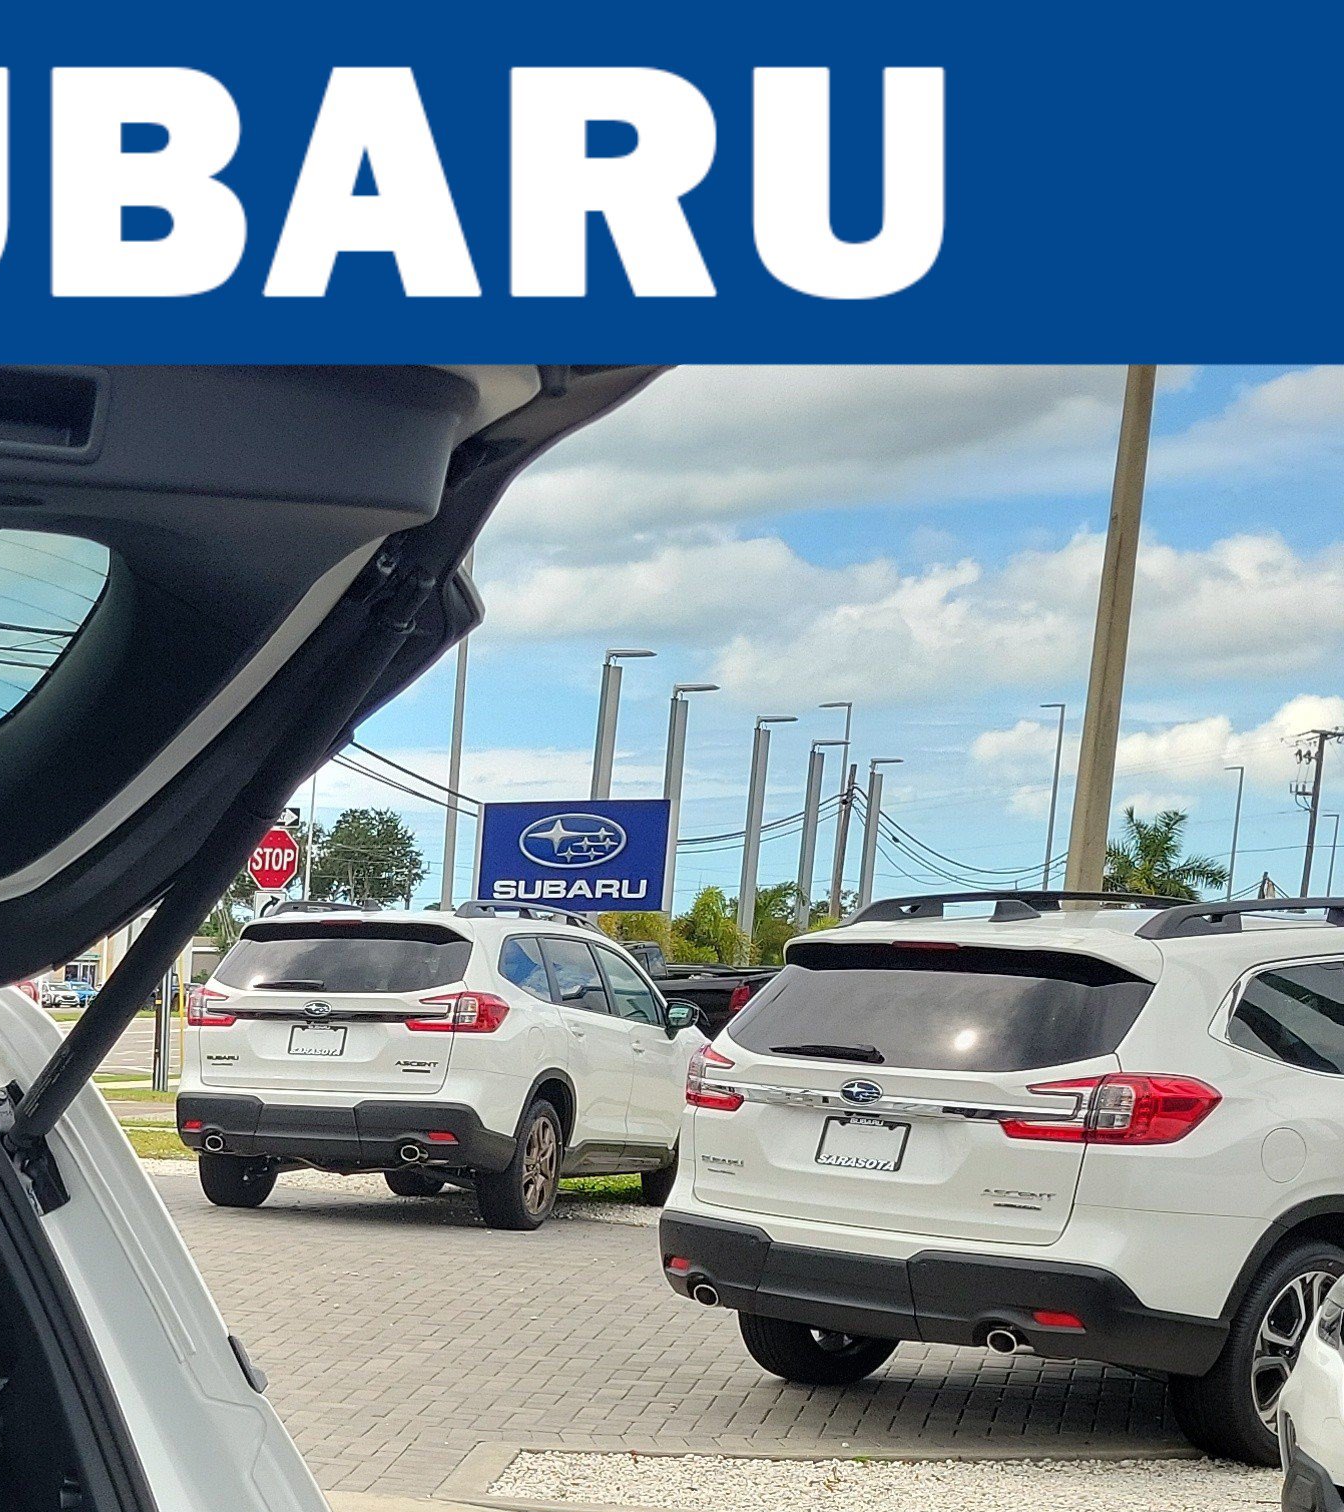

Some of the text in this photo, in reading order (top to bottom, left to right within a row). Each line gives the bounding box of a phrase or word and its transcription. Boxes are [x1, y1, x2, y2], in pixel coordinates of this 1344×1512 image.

[252, 847, 295, 871] STOP
[492, 879, 648, 899] SUBARU
[817, 1153, 895, 1171] SARASOTA
